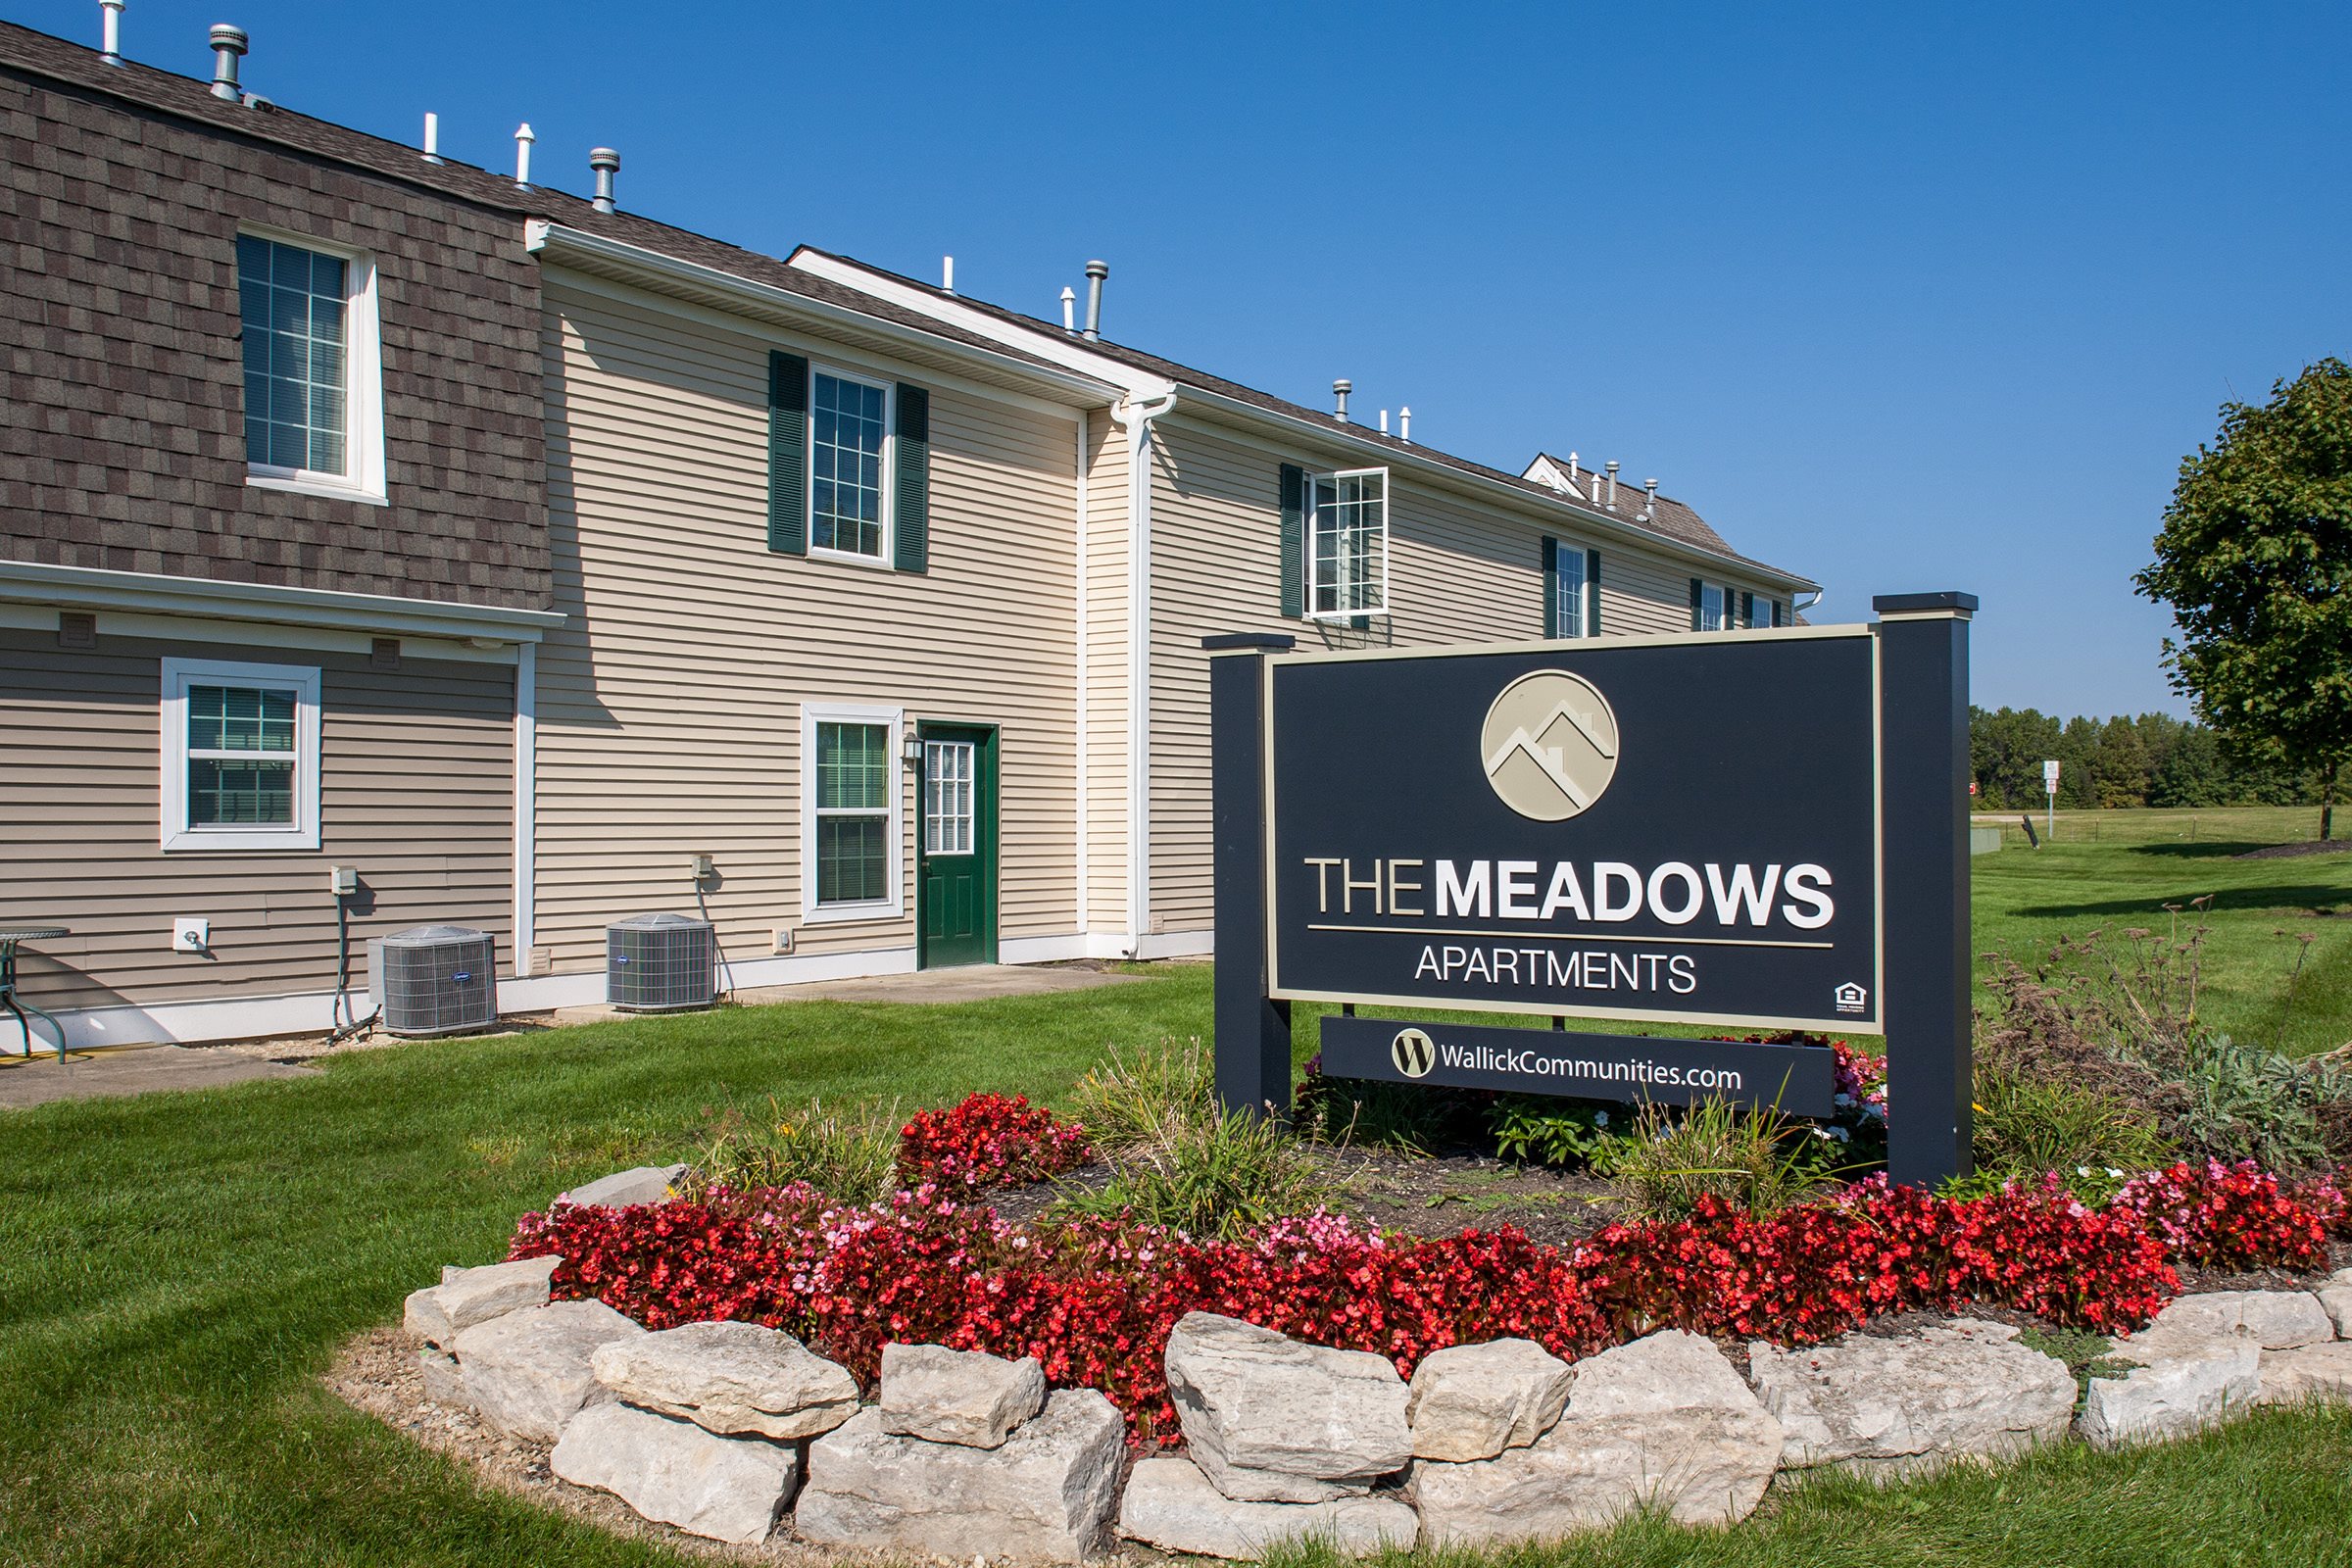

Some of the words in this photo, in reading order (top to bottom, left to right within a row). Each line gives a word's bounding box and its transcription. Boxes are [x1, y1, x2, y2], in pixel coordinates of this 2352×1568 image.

[1304, 857, 1426, 916] THE
[1435, 859, 1835, 929] MEADOWS
[1414, 946, 1696, 994] APARTMENTS
[1395, 1036, 1433, 1074] W
[1441, 1044, 1741, 1090] WallickCommunities.com
